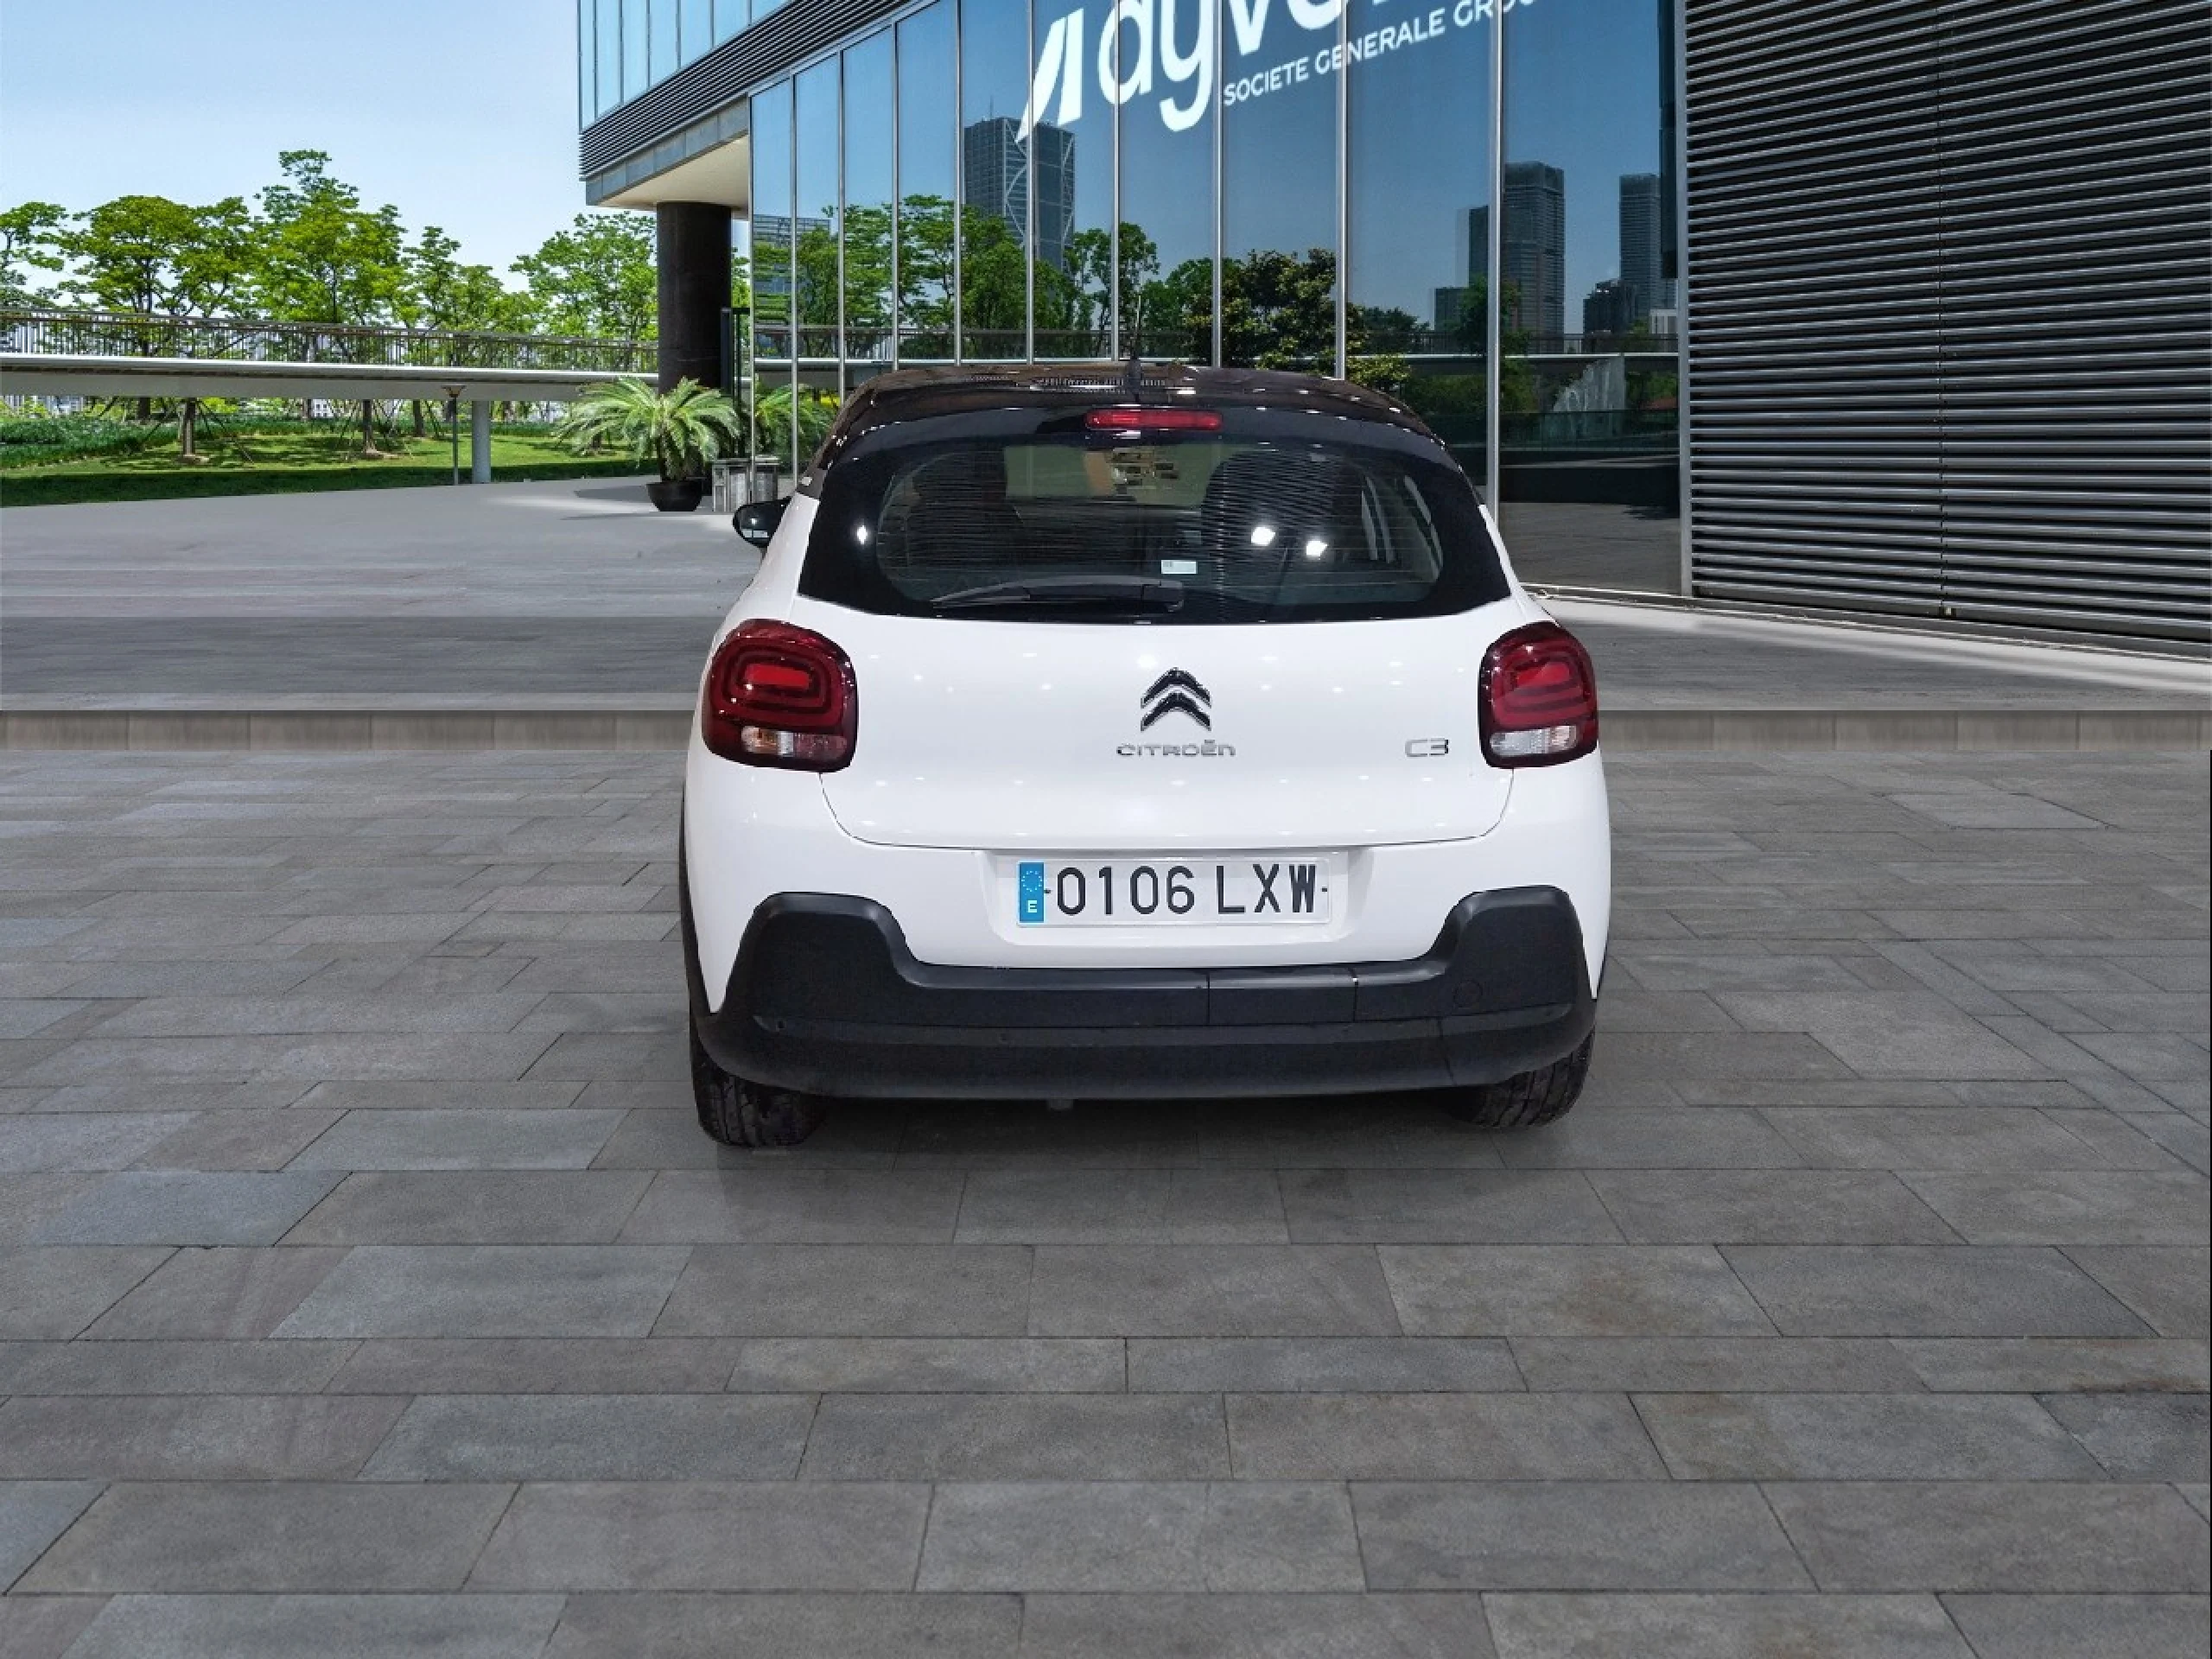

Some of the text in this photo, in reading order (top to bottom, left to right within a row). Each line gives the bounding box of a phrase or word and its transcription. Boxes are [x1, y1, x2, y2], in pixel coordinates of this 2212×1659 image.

[1223, 55, 1310, 106] SOCIETE
[1313, 8, 1446, 74] GENERALE
[1404, 737, 1450, 758] C3
[1027, 899, 1038, 913] E
[1056, 864, 1317, 916] 0106 LXW
